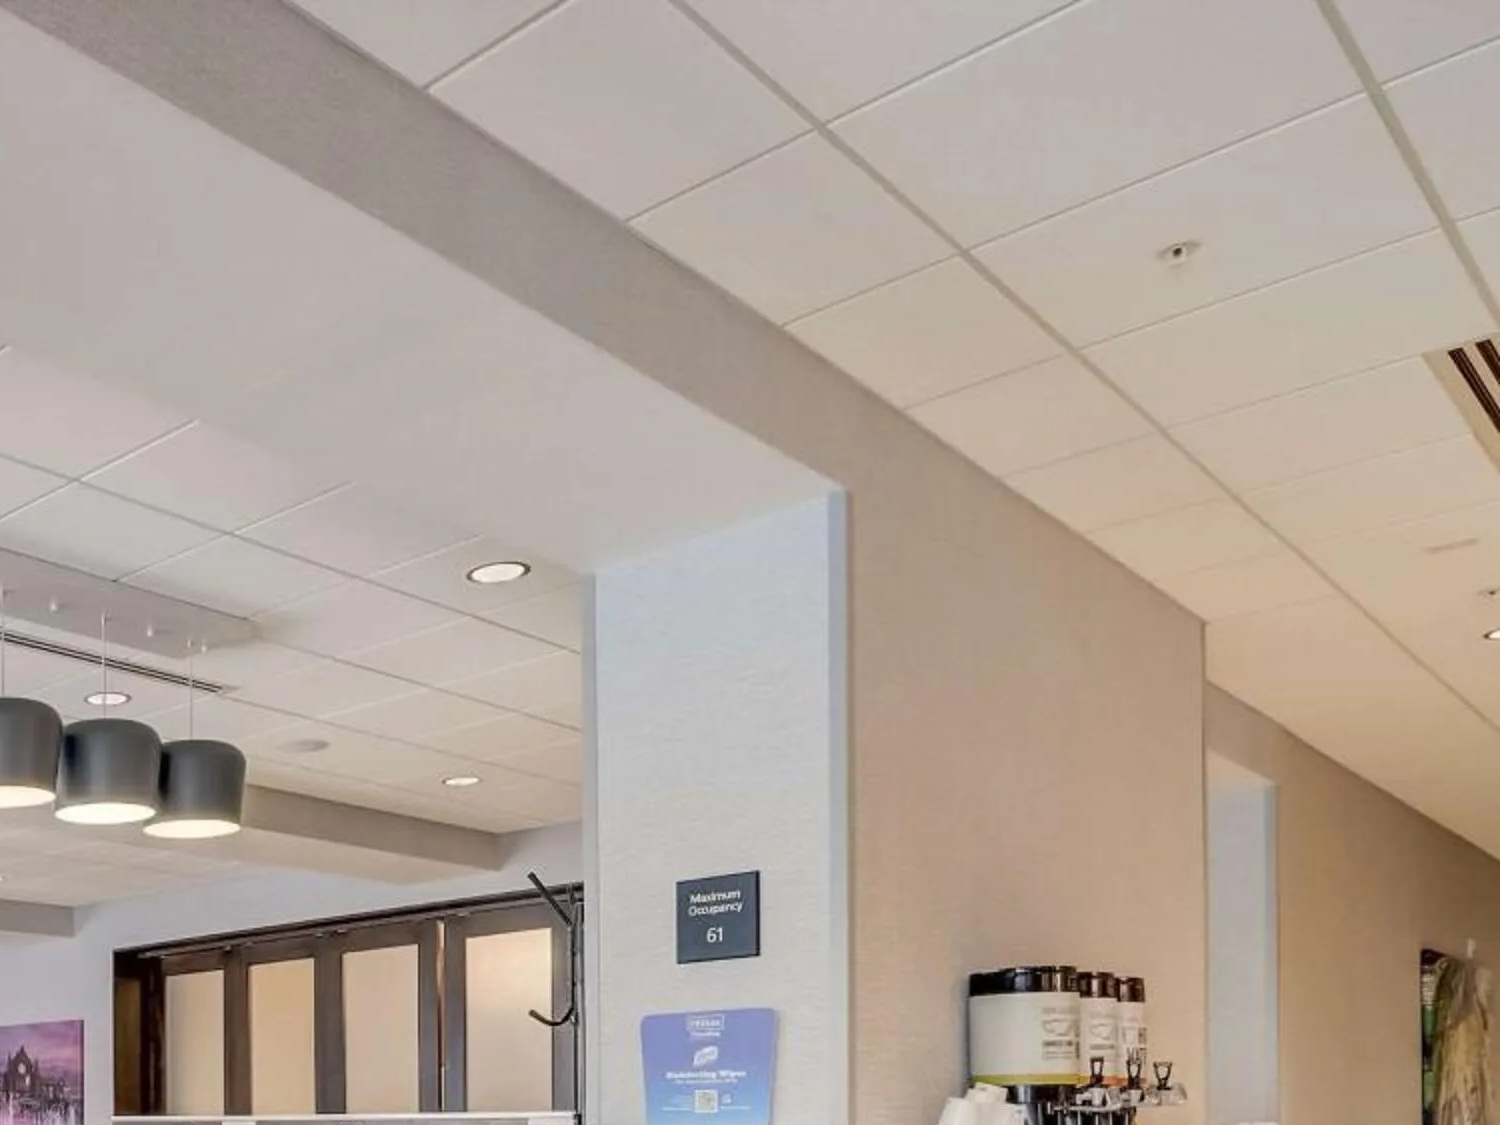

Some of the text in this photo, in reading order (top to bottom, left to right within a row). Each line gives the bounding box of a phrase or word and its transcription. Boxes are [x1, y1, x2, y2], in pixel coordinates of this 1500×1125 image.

[689, 890, 741, 904] Maximum
[688, 901, 744, 916] Occupancy
[706, 927, 723, 943] 61
